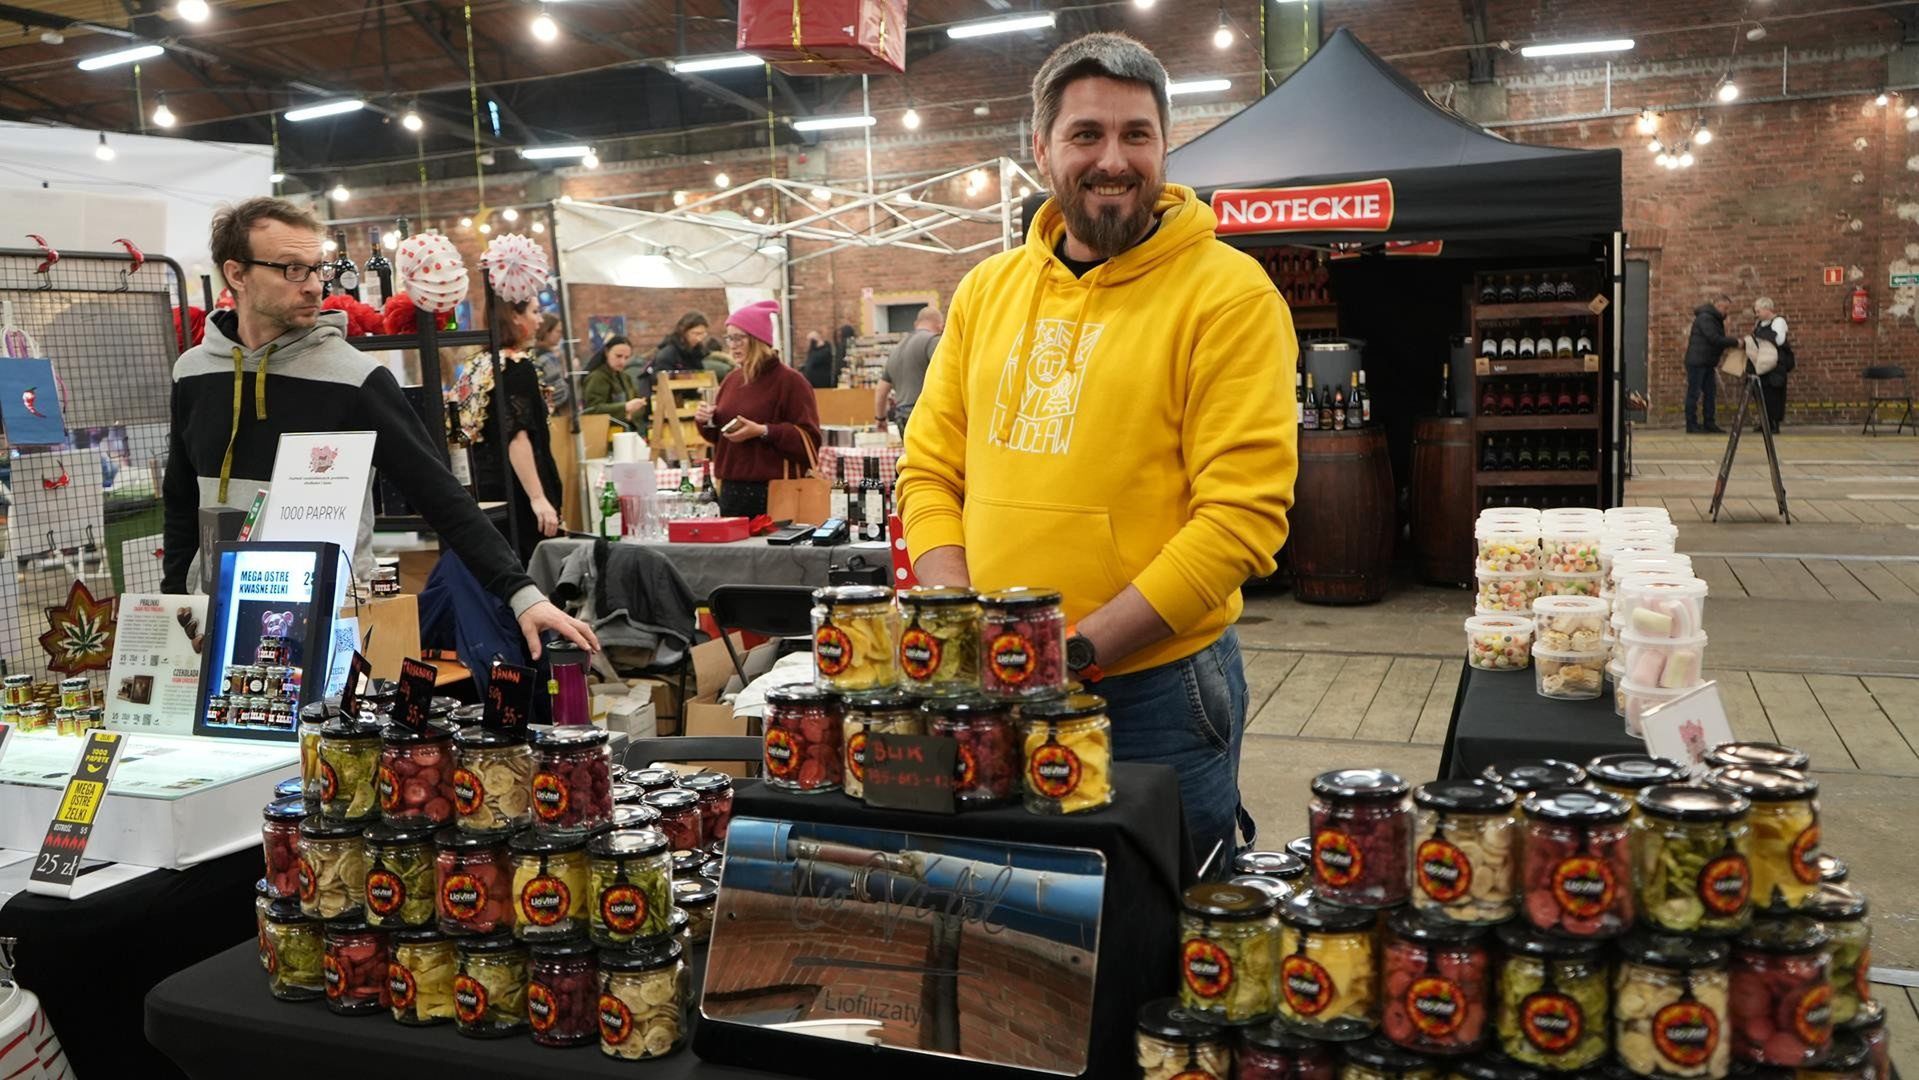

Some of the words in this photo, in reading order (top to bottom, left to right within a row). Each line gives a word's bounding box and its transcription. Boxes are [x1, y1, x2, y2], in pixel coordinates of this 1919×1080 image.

[1221, 195, 1381, 225] NOTECKIE
[280, 506, 304, 520] 1000
[305, 505, 347, 521] PAPRYK
[241, 570, 262, 582] MEGA
[264, 571, 289, 583] OSTRE
[75, 781, 96, 796] MEGA
[70, 795, 91, 807] OSTRE
[64, 806, 87, 821] ŻELKI
[36, 852, 61, 875] 25
[62, 854, 79, 876] zł
[824, 989, 922, 1026] Liofilizaty
